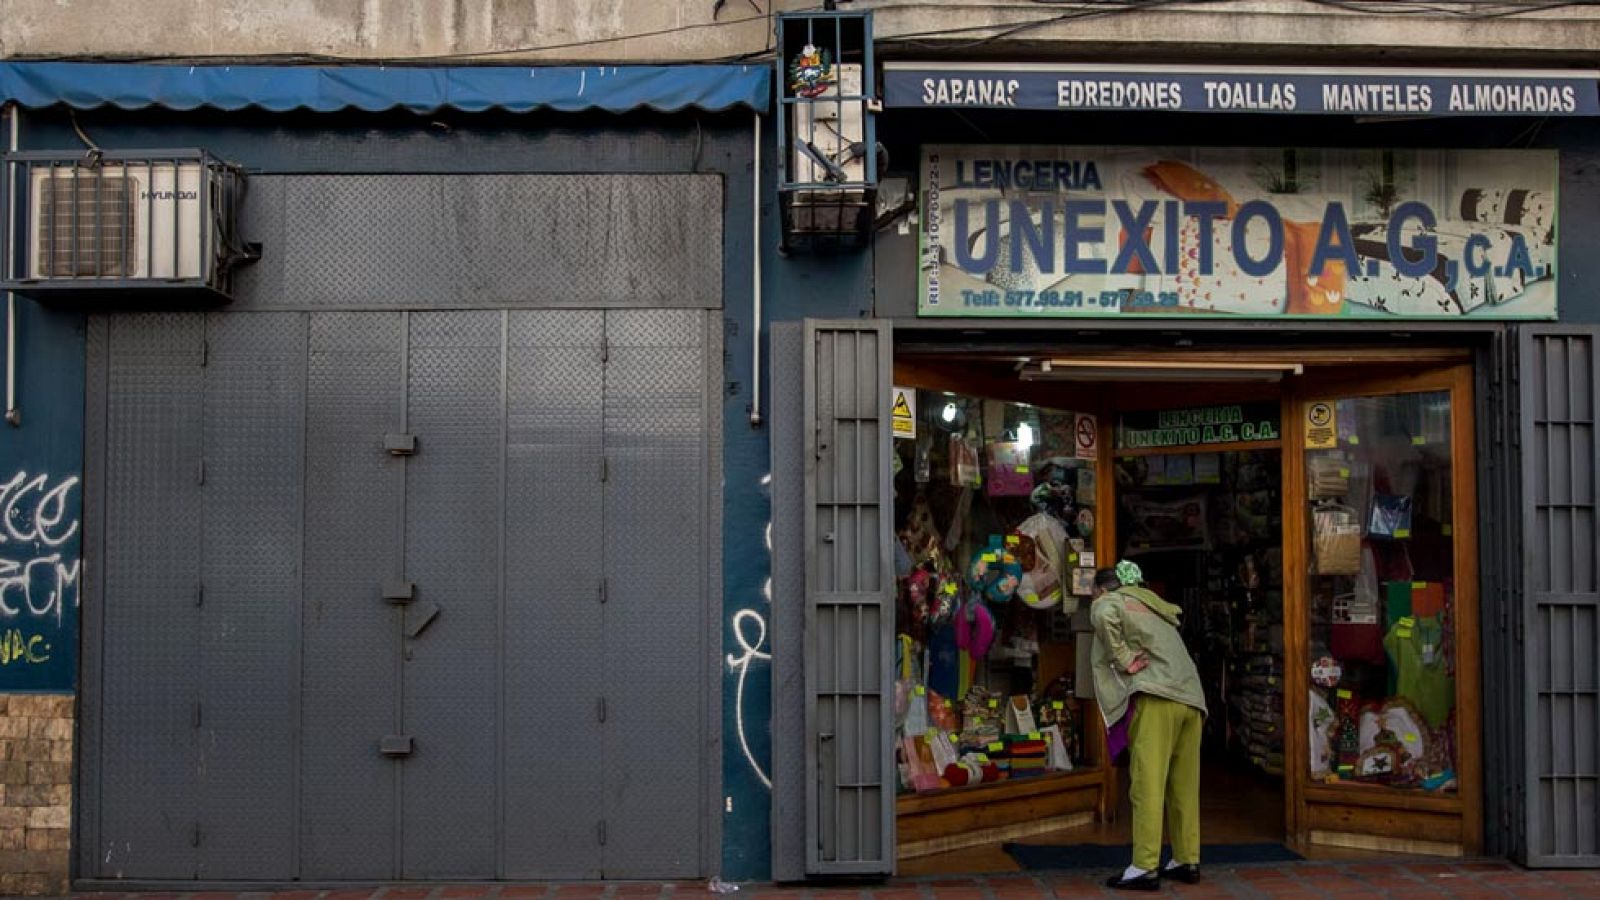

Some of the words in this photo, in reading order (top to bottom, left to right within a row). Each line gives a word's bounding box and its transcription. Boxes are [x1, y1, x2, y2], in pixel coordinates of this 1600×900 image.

[1057, 80, 1182, 109] EDREDONES
[1204, 81, 1296, 111] TOALLAS
[1322, 84, 1433, 112] MANTELES
[1449, 84, 1576, 113] ALMOHADAS
[955, 159, 1102, 191] LENCERIA
[141, 190, 197, 200] HYUNDAI
[954, 199, 1284, 277] UNEXITO
[1158, 405, 1243, 428] LENCERIA
[1127, 427, 1200, 448] UNEXITO
